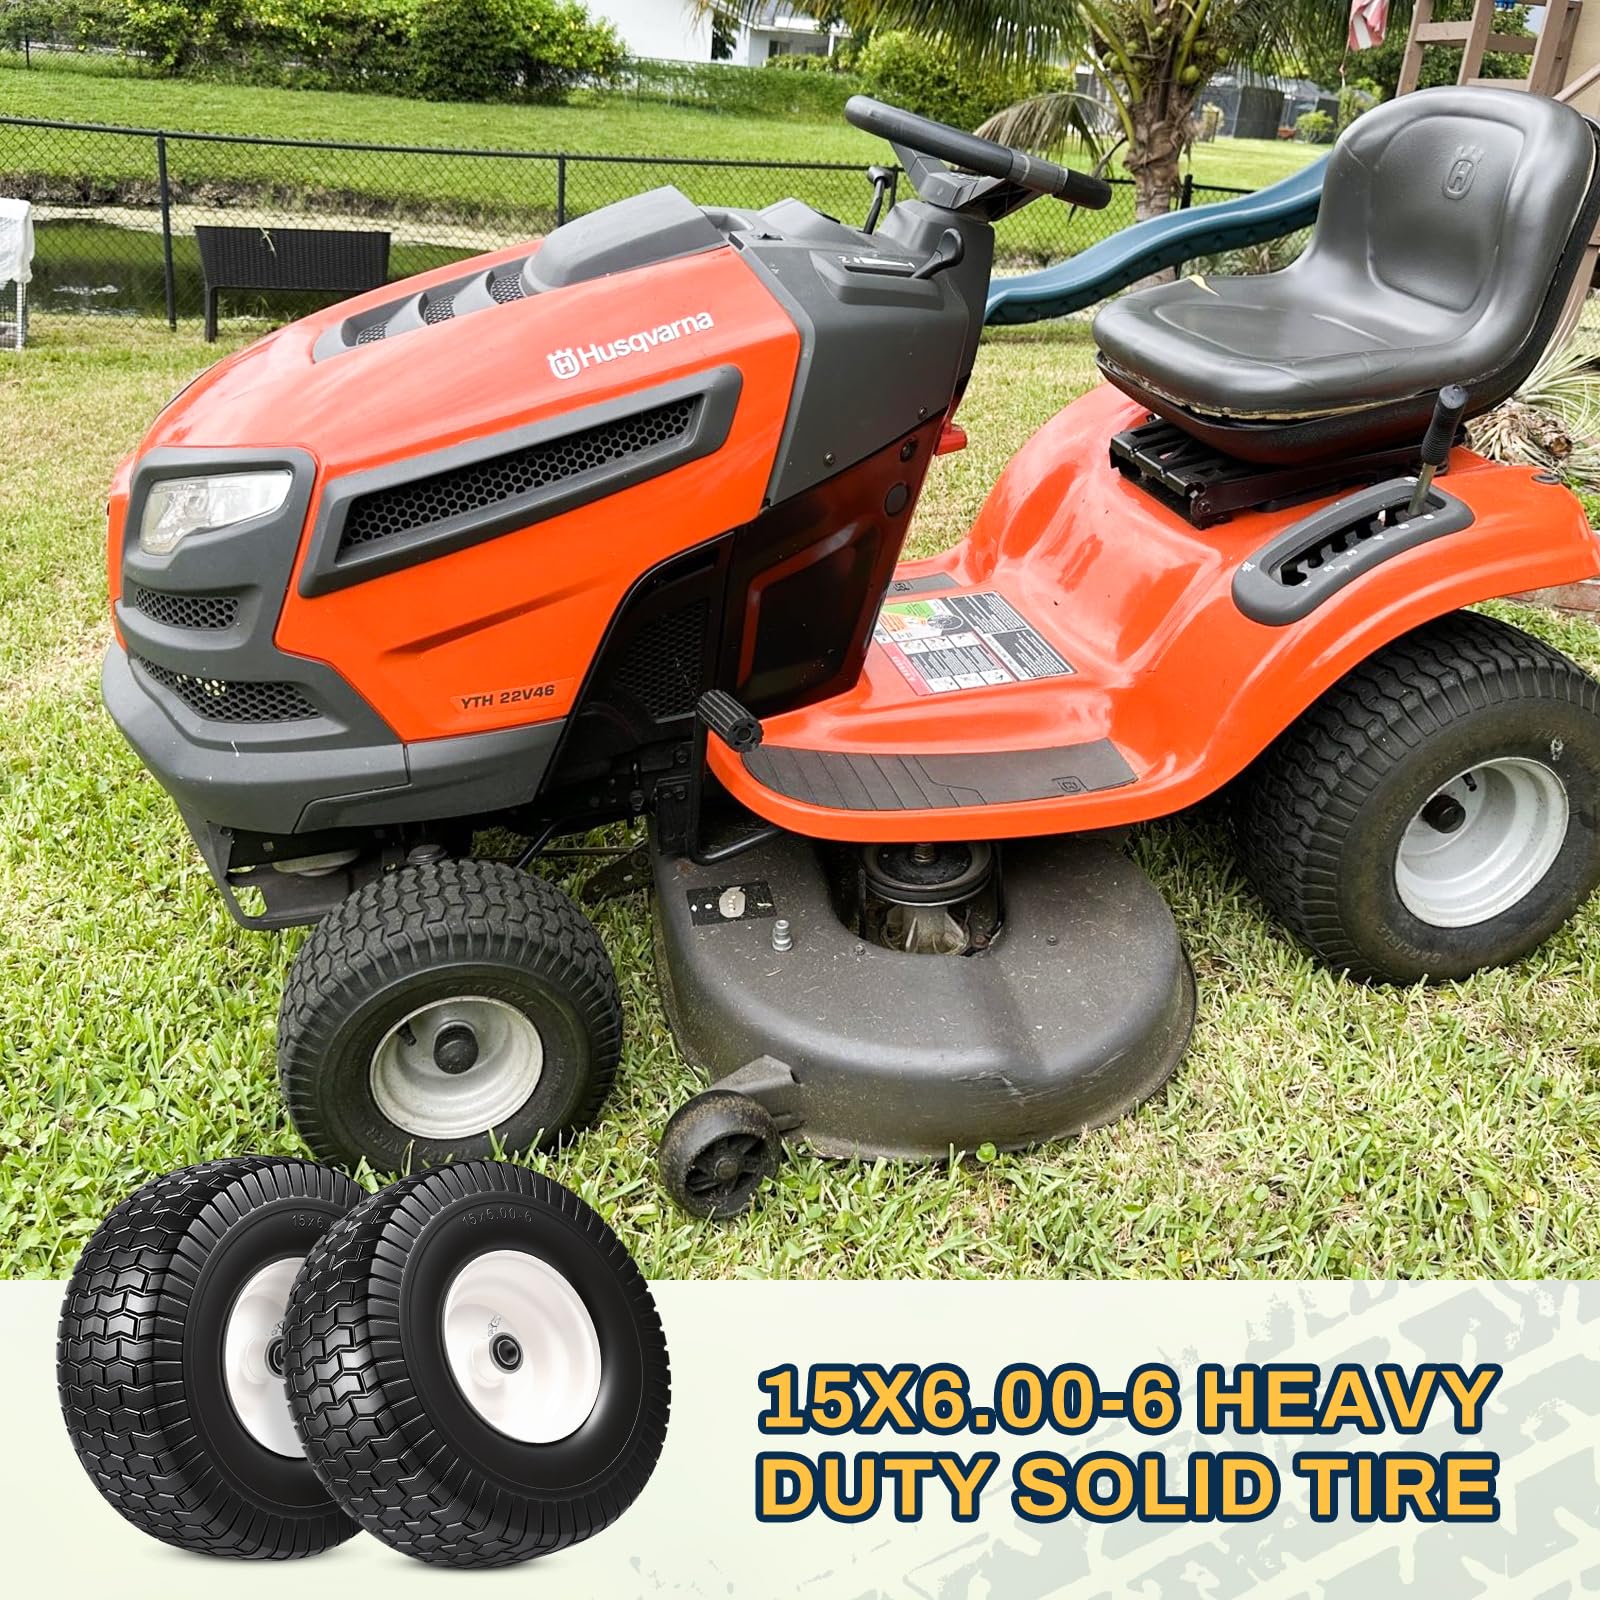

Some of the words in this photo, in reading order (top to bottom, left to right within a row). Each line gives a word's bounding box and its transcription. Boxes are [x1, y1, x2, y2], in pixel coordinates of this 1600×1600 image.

[576, 311, 714, 368] Husqvarna
[461, 694, 493, 709] YTH
[500, 684, 555, 704] 22V46
